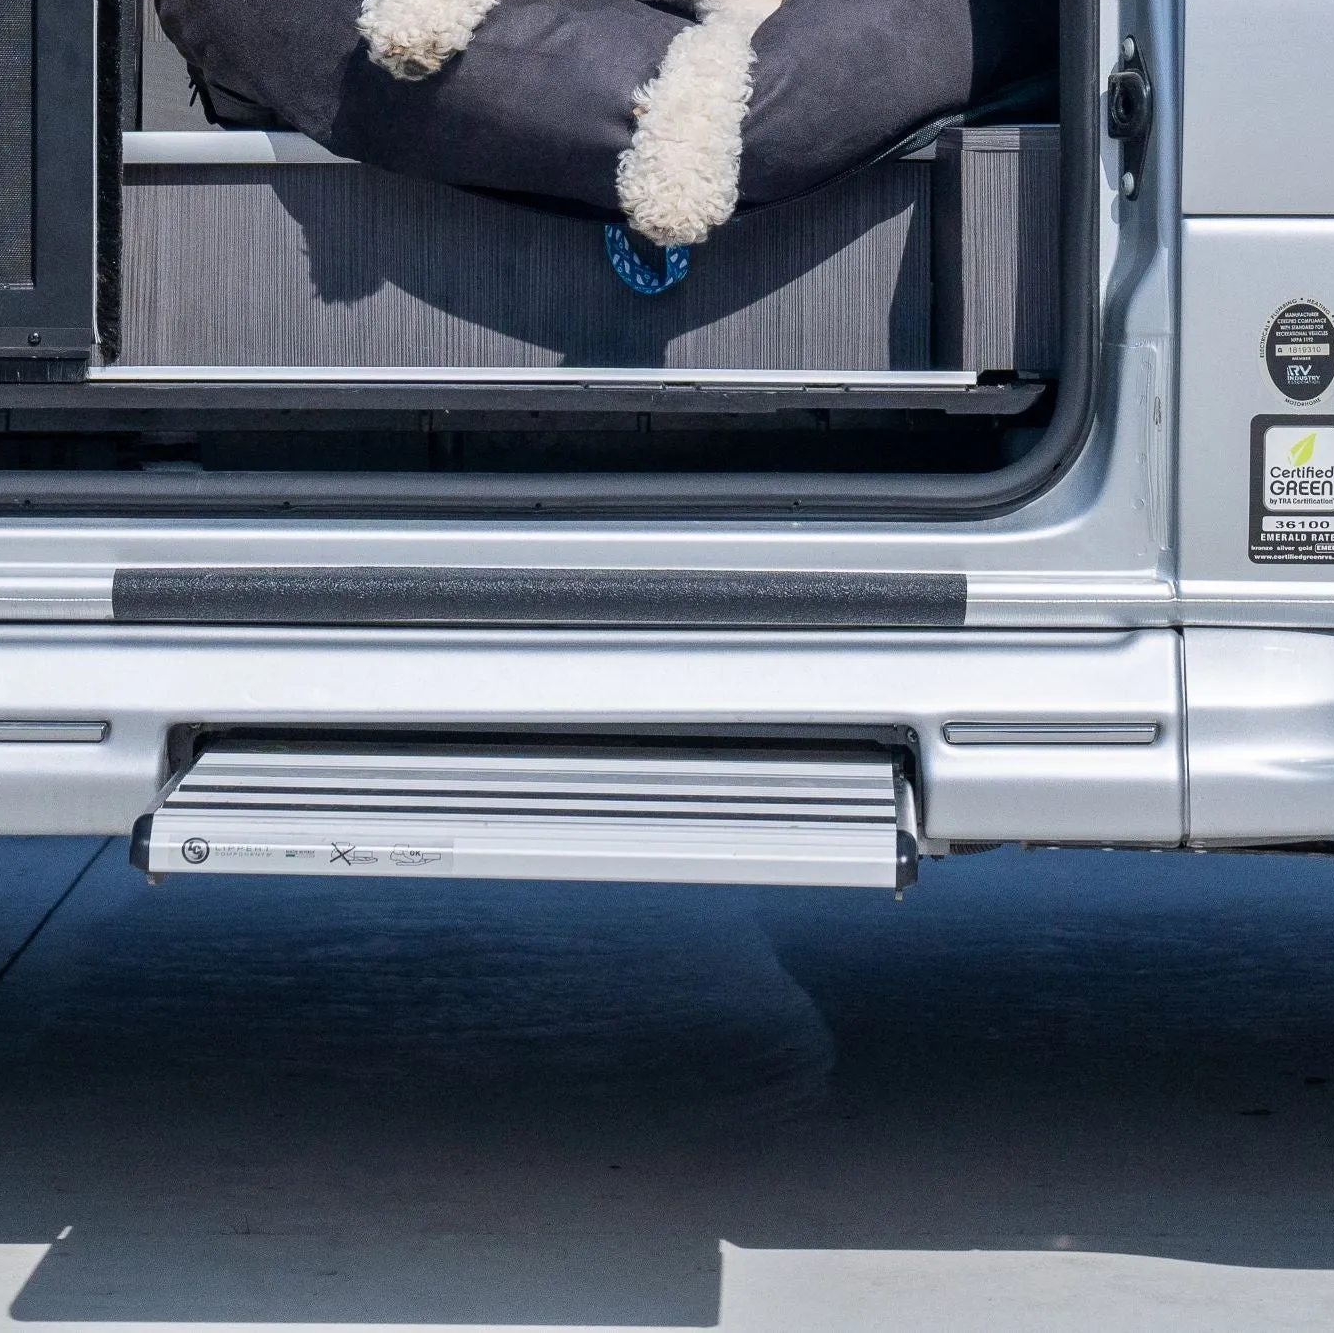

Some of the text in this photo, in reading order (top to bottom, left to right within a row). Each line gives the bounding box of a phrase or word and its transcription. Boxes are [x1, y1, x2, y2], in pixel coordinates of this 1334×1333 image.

[1260, 325, 1270, 358] ELECTRICAL
[1270, 298, 1298, 320] PLUMBING
[1306, 298, 1331, 315] HEATING
[1288, 364, 1312, 375] RV
[1284, 397, 1321, 406] MOTORHOME
[1270, 466, 1334, 478] Certified
[1270, 480, 1333, 496] GREEN
[1275, 520, 1330, 529] 36100
